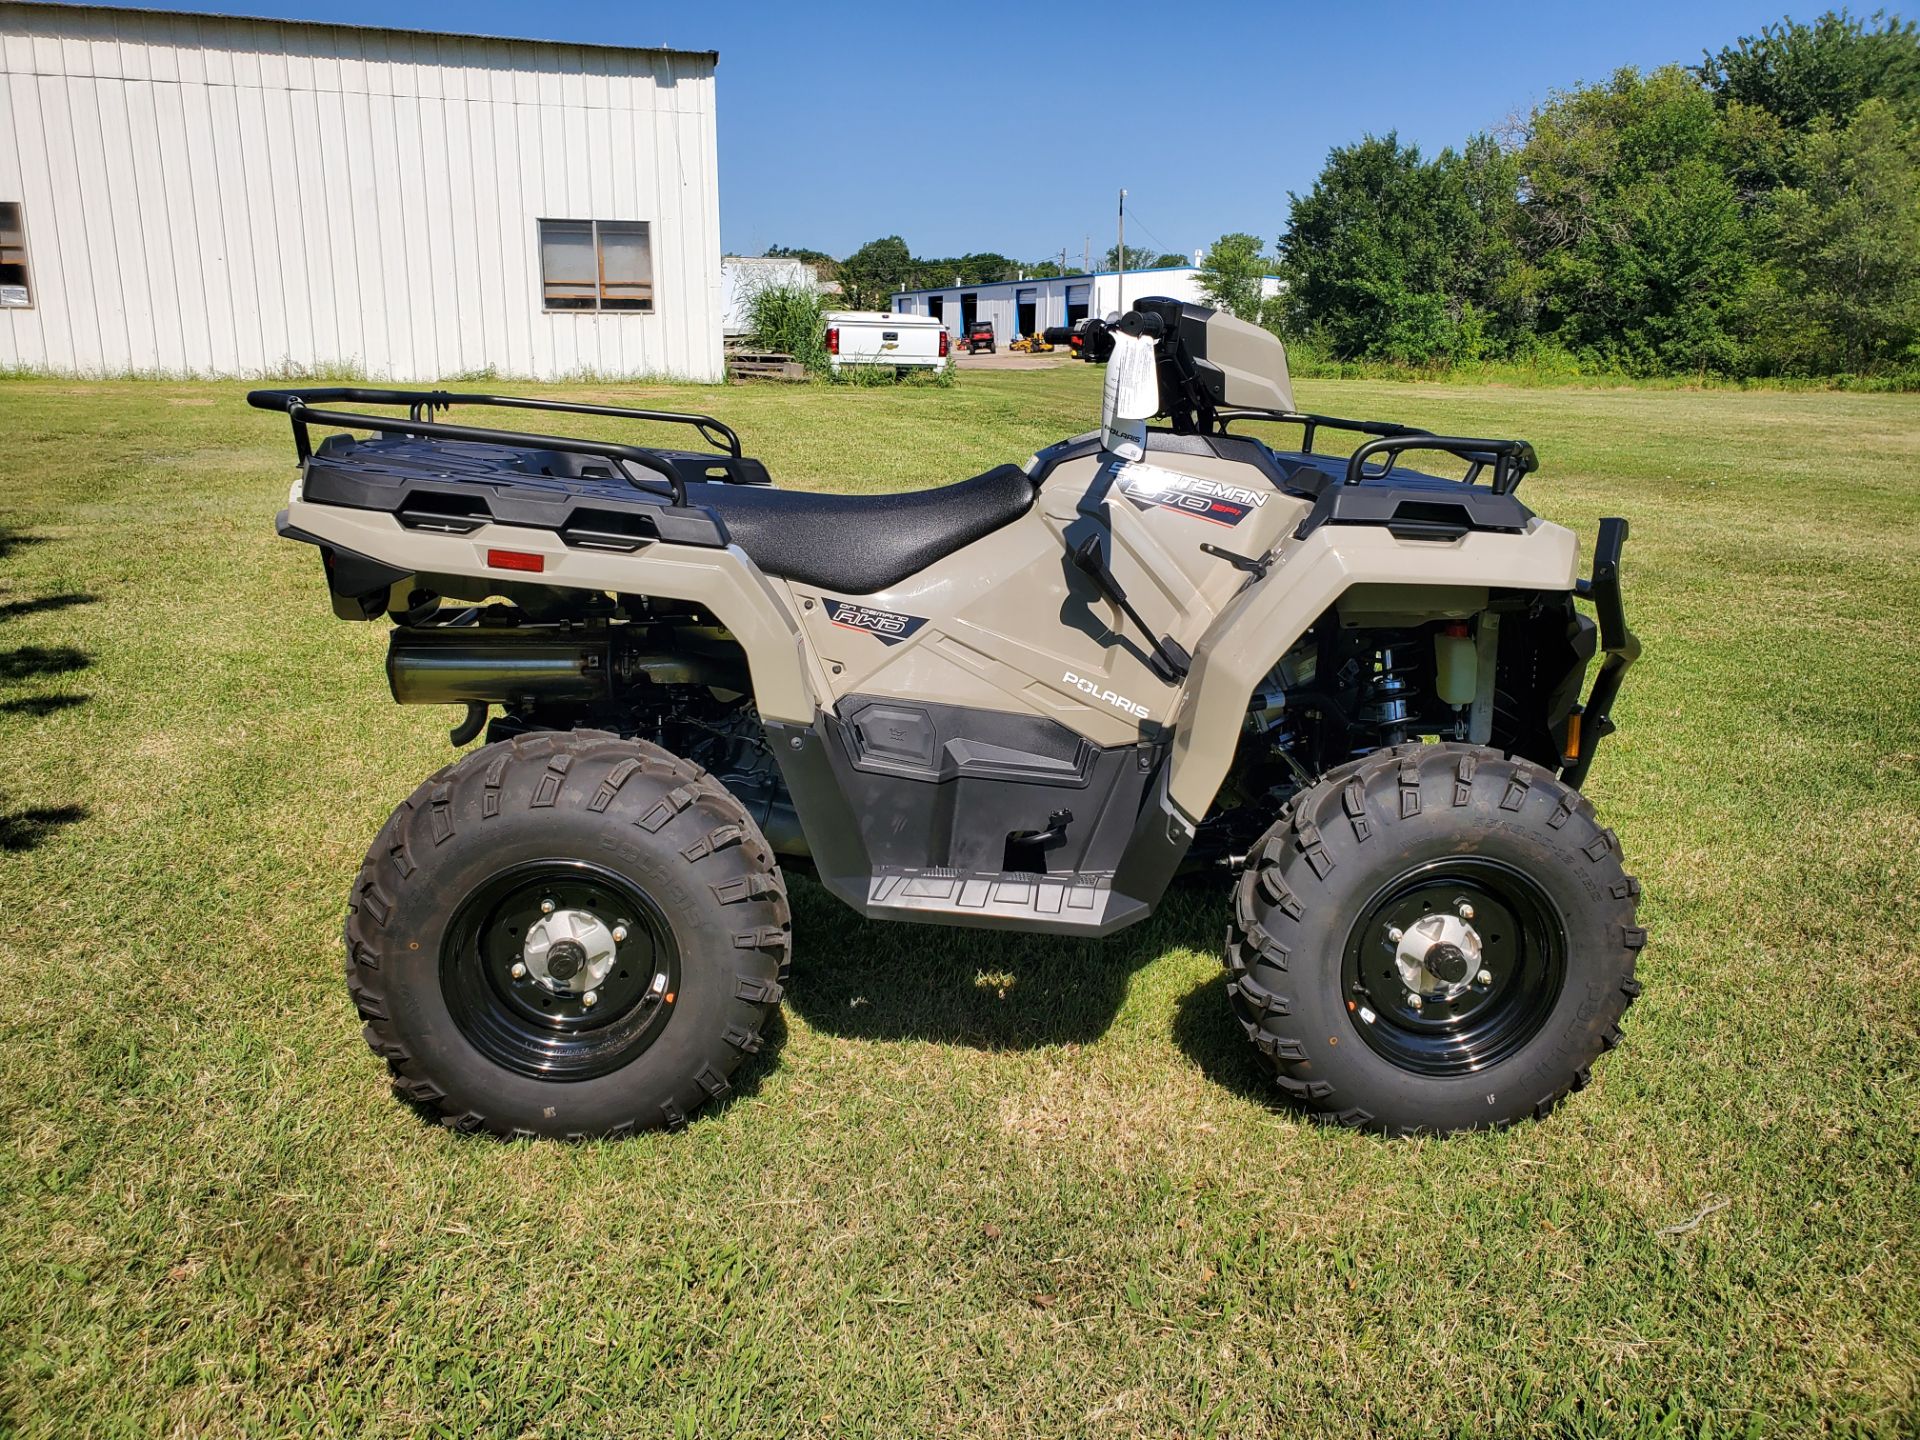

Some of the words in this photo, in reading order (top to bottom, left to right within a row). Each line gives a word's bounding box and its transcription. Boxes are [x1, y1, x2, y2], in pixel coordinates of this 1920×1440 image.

[1104, 424, 1141, 442] POLARIS
[833, 609, 906, 633] AWD
[1062, 671, 1150, 719] POLARIS
